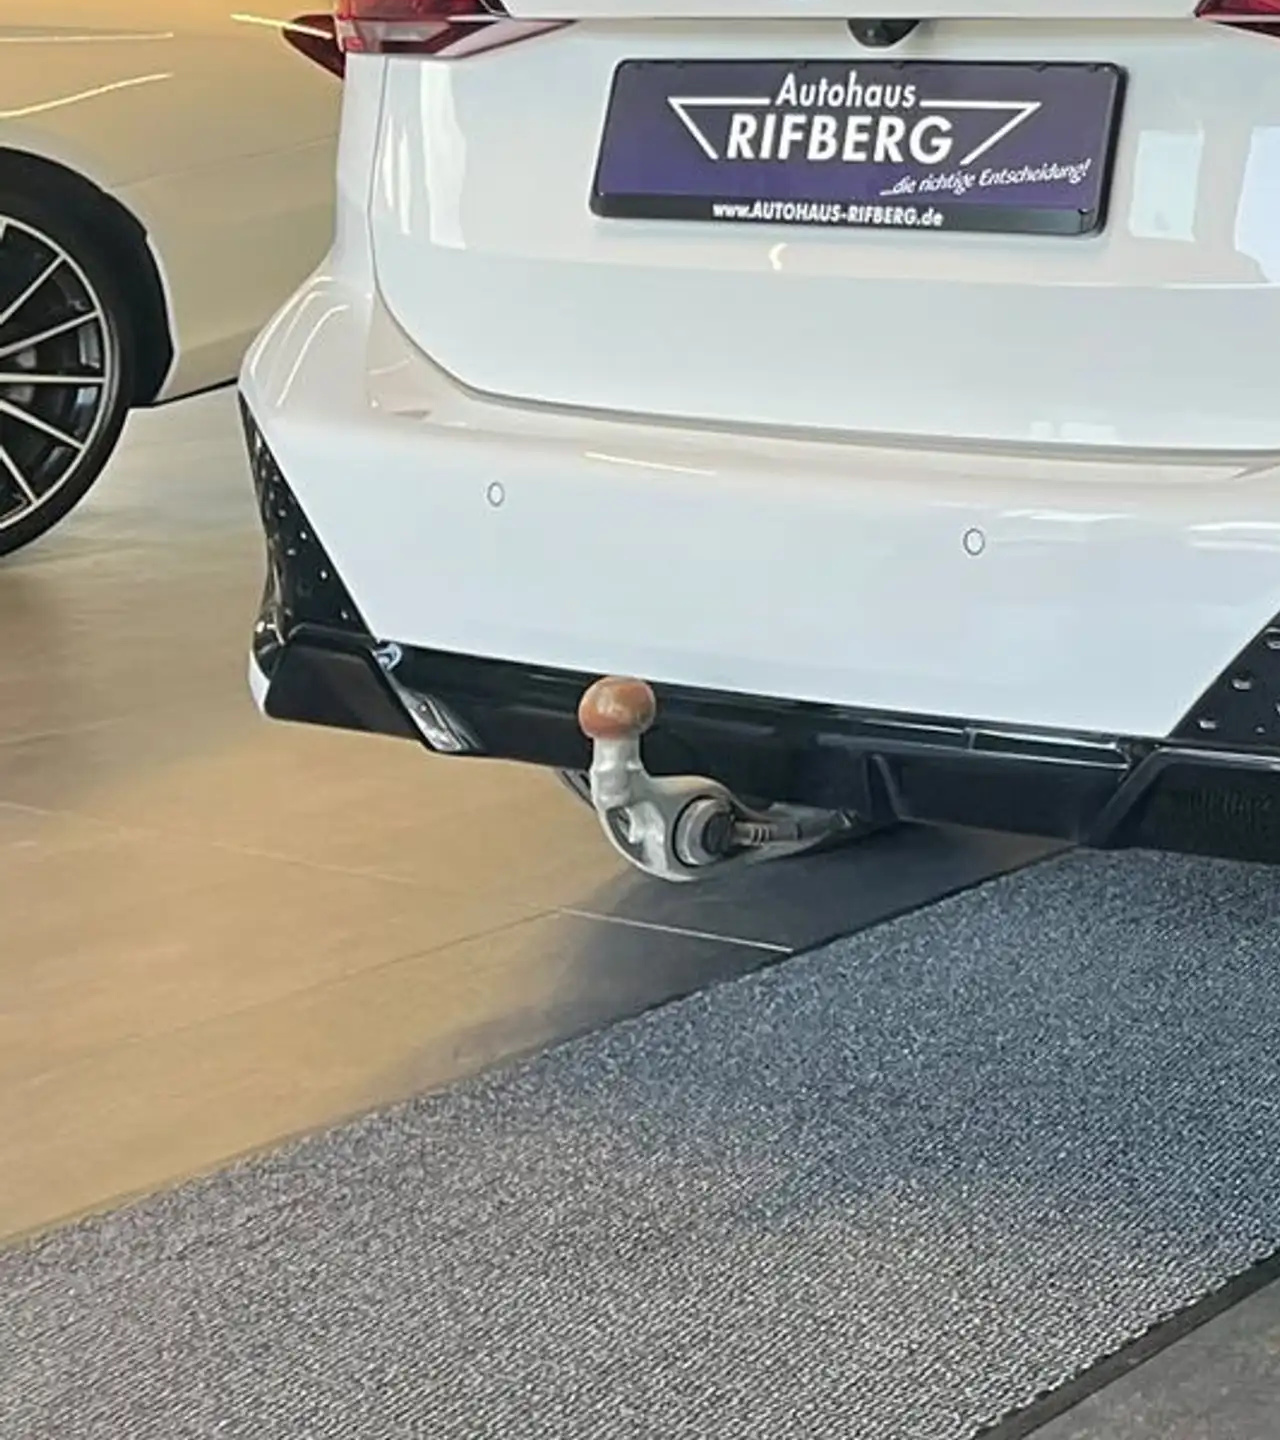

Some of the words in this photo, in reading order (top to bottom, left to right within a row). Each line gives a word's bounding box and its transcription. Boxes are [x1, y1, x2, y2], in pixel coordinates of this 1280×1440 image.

[775, 69, 916, 109] Autohaus
[726, 112, 953, 164] RIFBERG
[918, 170, 976, 196] richtige
[979, 158, 1092, 186] Entscheidung!
[712, 199, 944, 227] www.AUTOHAUS-RIFBERG.de
